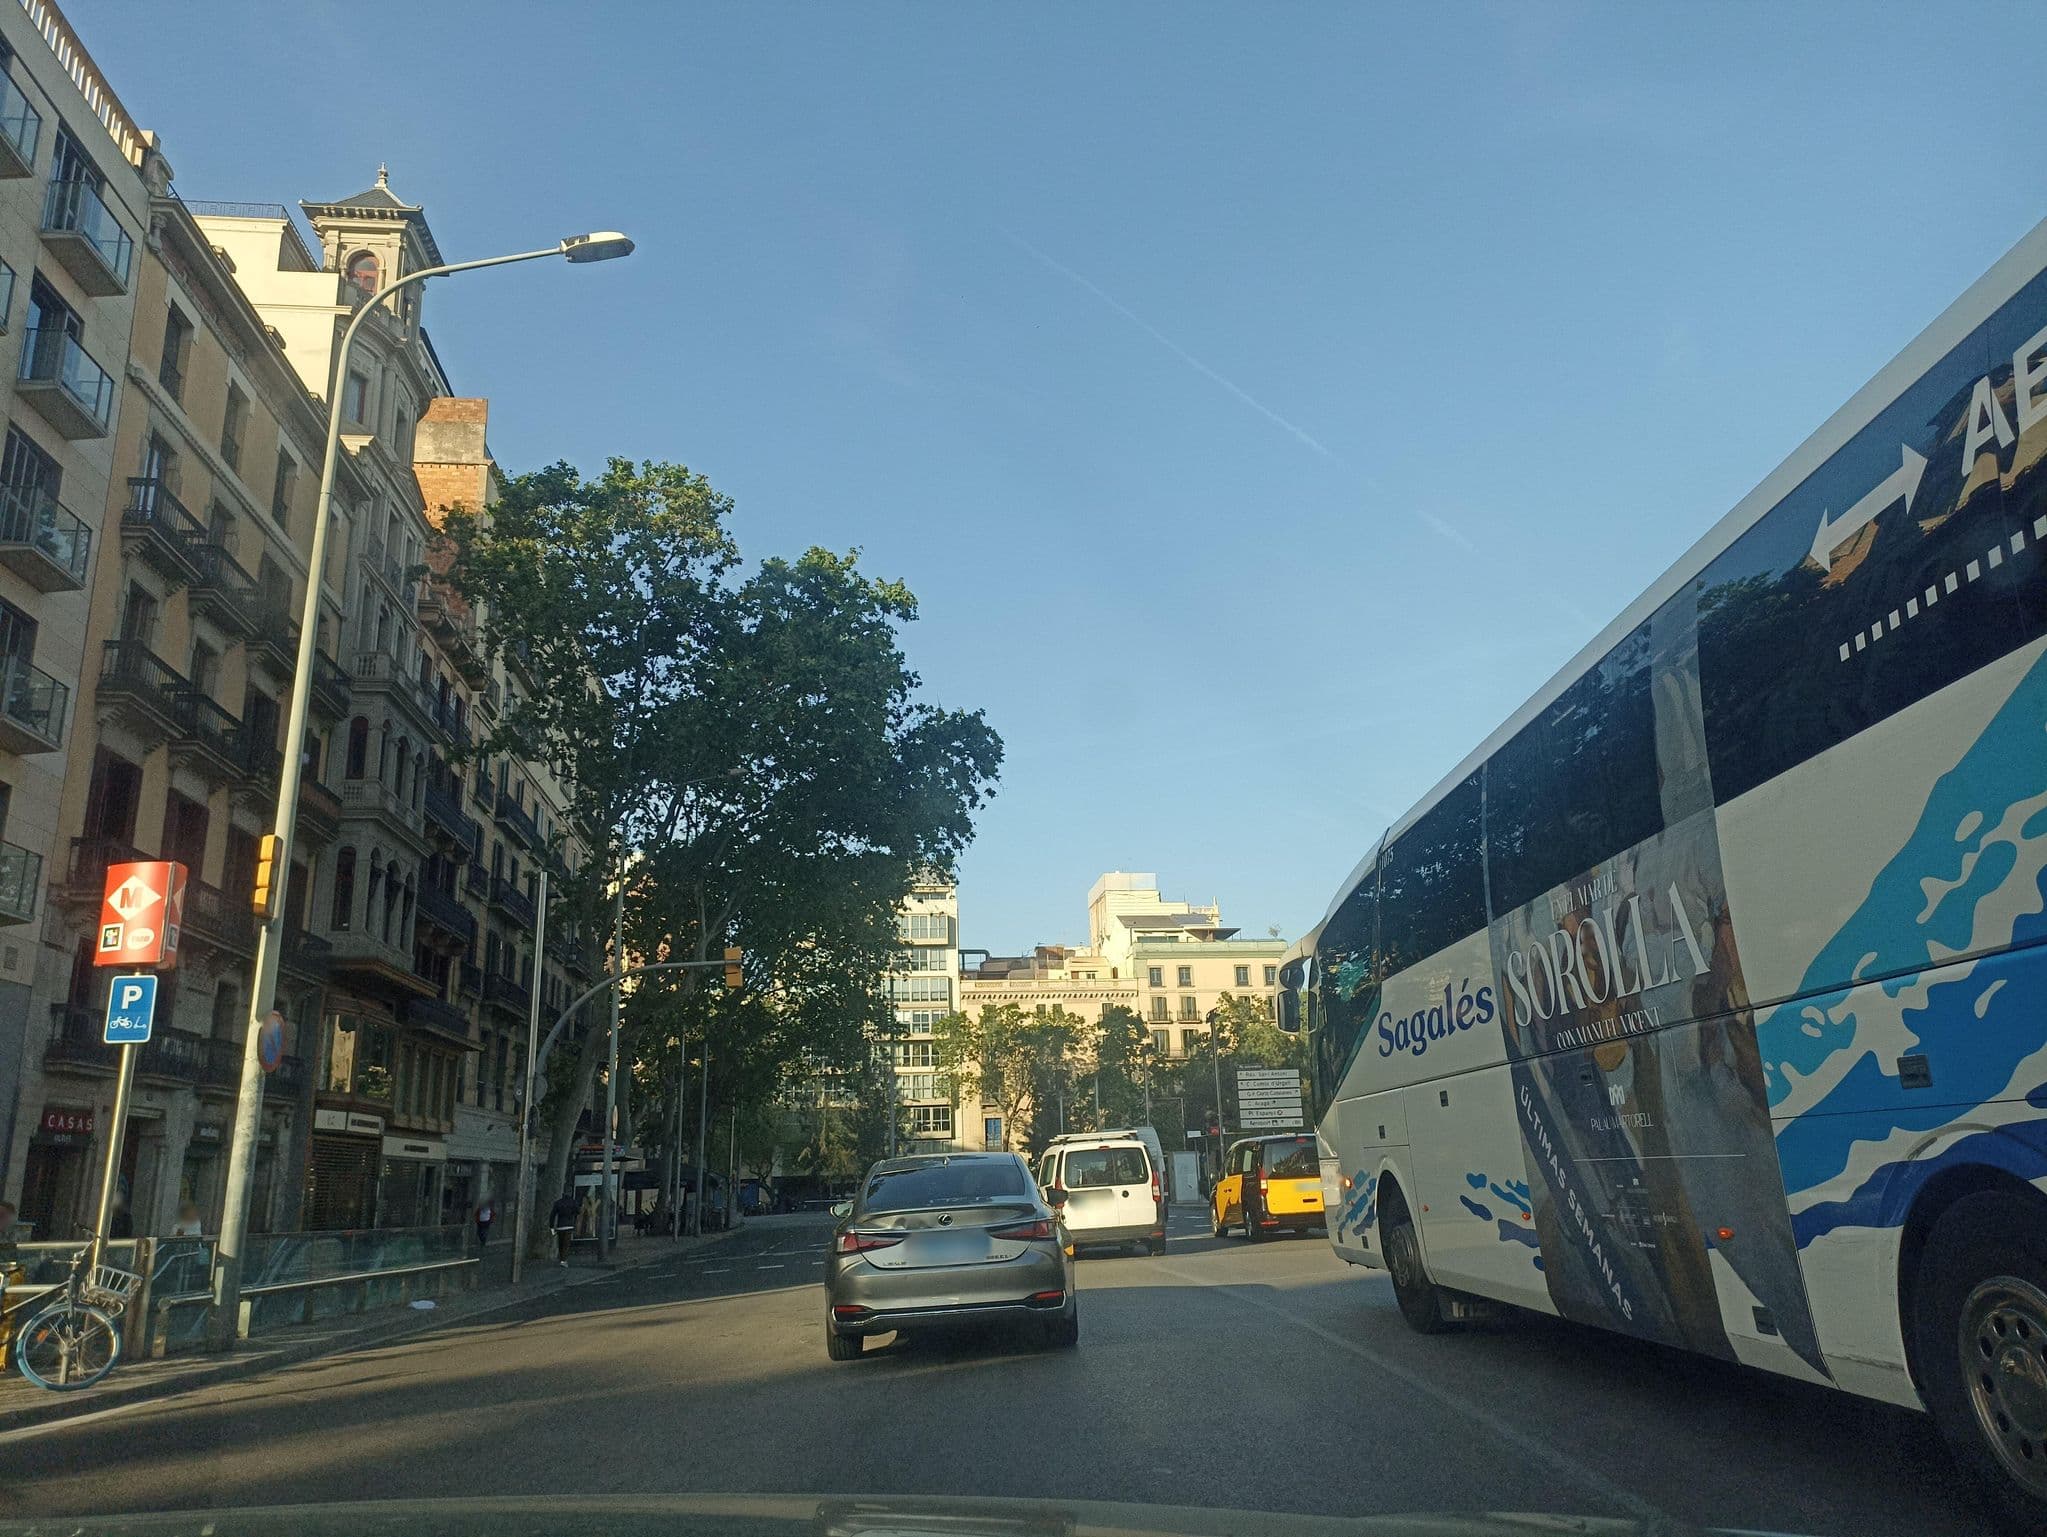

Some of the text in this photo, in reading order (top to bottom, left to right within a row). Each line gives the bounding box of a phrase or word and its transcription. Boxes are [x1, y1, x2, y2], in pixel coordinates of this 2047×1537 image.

[120, 887, 143, 908] M
[1577, 878, 1602, 906] MAR
[1603, 871, 1618, 896] DE
[1507, 881, 1711, 1027] SOROLLA
[122, 985, 143, 1009] P
[1378, 977, 1494, 1057] Sagalés
[1556, 1007, 1661, 1050] CON MANUEL VICENT
[48, 1114, 93, 1131] CASAS
[1520, 1085, 1633, 1321] ÚLTIMAS SEMANAS
